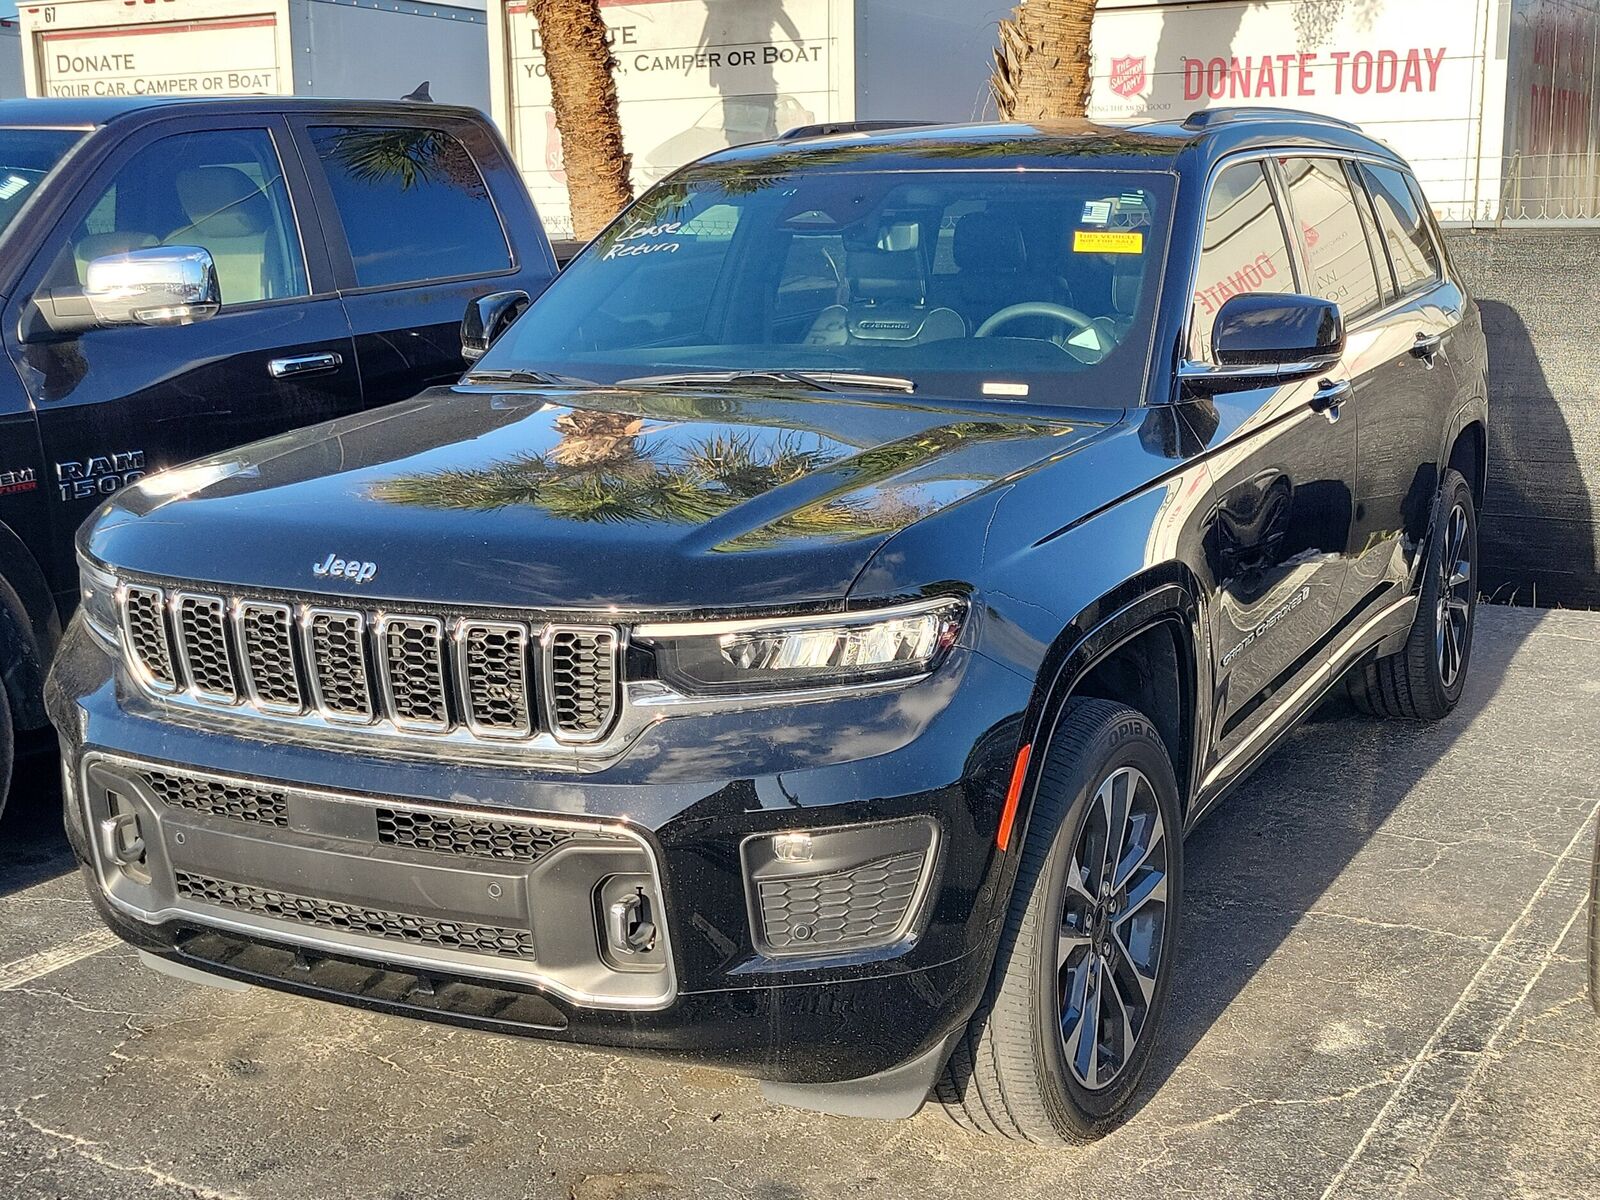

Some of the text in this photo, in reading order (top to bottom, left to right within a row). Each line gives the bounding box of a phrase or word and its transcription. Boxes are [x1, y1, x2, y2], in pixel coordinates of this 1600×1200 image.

[44, 7, 56, 23] 67
[531, 26, 637, 50] DTE
[56, 54, 135, 73] DONATE
[634, 52, 721, 72] CAMPER
[727, 51, 756, 66] OR
[763, 46, 822, 65] BOAT
[53, 84, 90, 97] YOUR
[134, 79, 198, 95] CAMPER
[202, 77, 223, 90] OR
[228, 73, 272, 88] BOAT
[1183, 47, 1447, 101] DONATE TODAY
[615, 218, 681, 242] Lease
[603, 243, 679, 261] Return
[0, 467, 36, 488] EMI
[56, 451, 145, 482] RAM
[312, 553, 378, 584] Jeep
